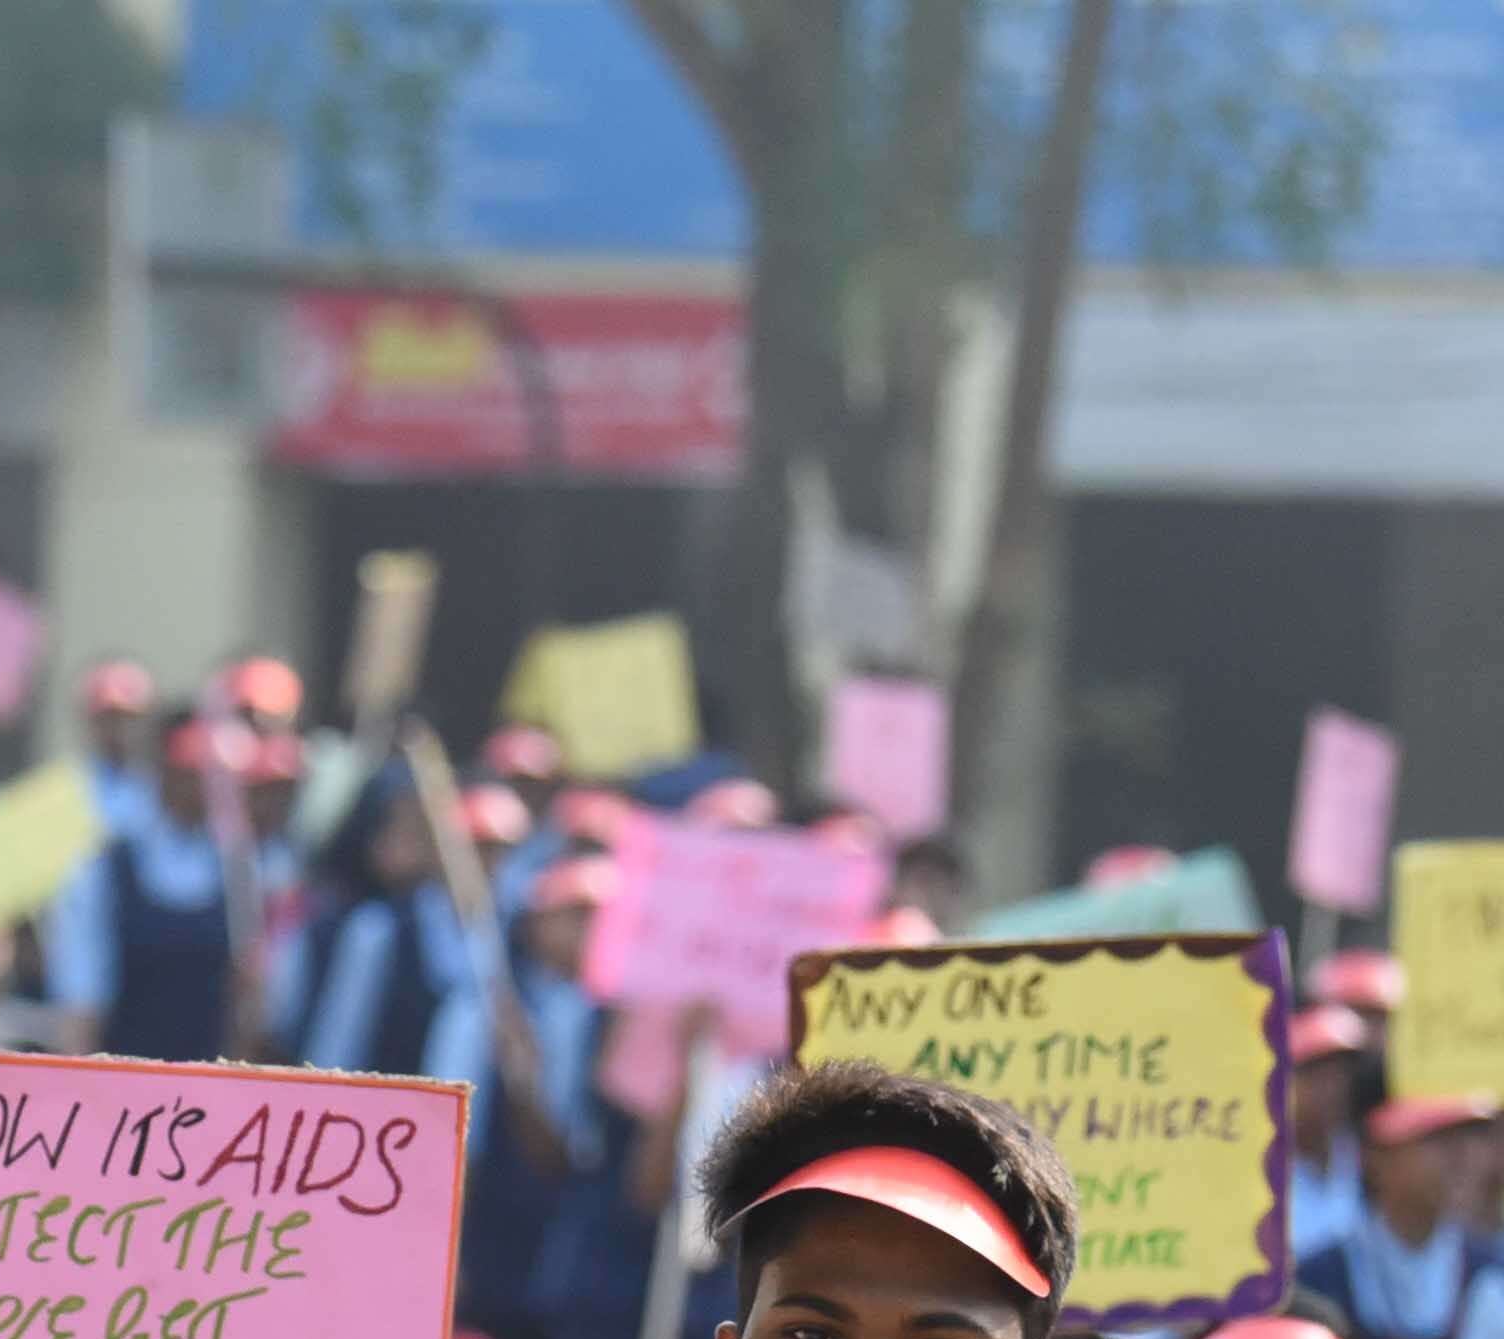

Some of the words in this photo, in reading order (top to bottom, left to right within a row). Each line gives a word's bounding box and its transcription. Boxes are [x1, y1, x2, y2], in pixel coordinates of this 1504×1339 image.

[820, 972, 928, 1032] ANY
[945, 971, 1049, 1020] ONE
[911, 1036, 1017, 1080] ANY
[1035, 1033, 1170, 1084] TIME
[1084, 1096, 1246, 1144] WHERE
[197, 1103, 418, 1216] AIDS
[162, 1197, 313, 1280] THE
